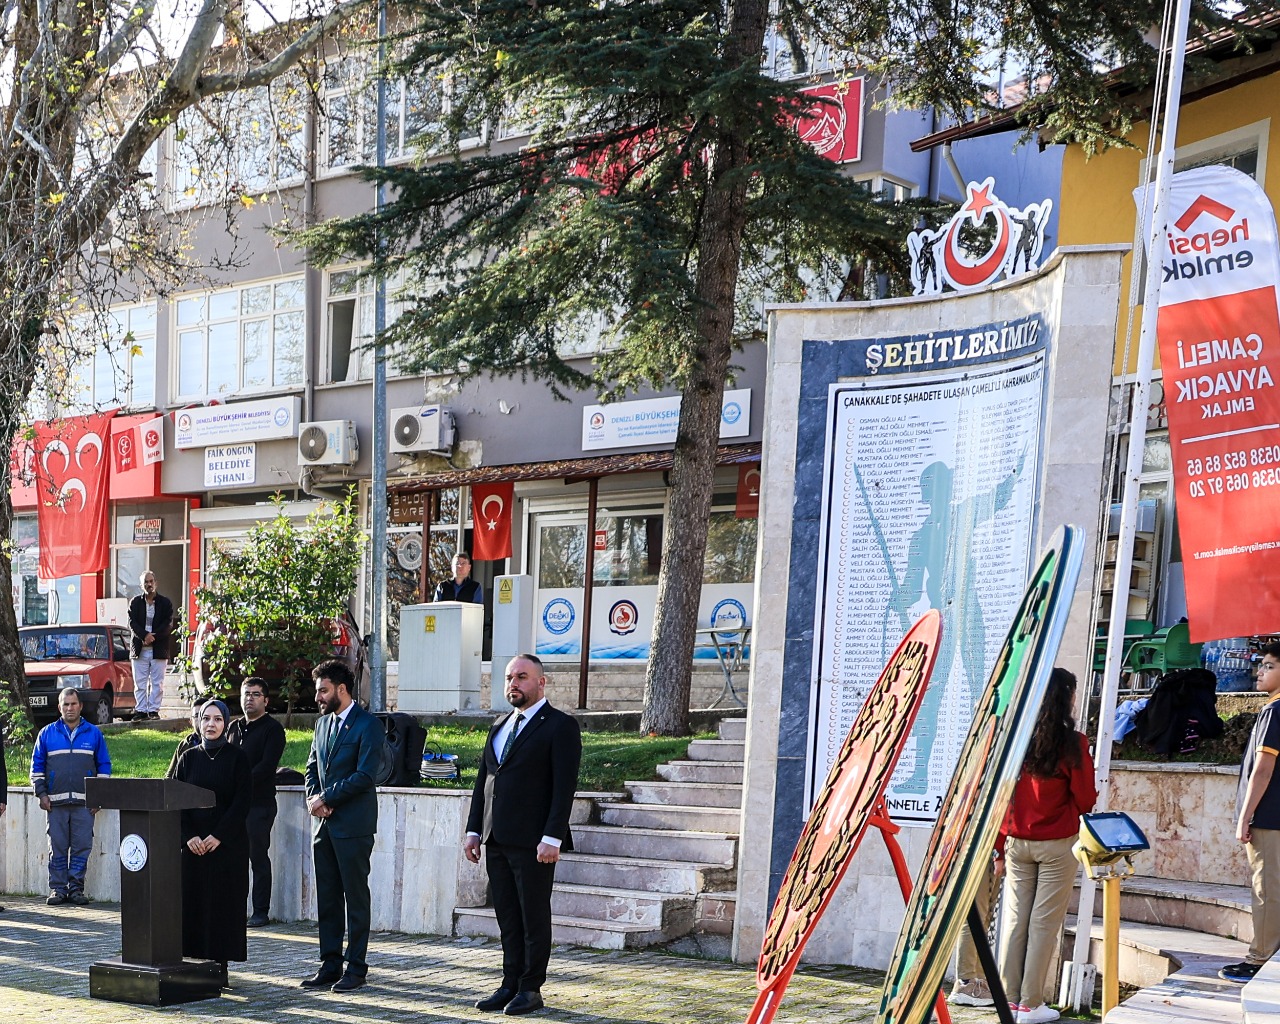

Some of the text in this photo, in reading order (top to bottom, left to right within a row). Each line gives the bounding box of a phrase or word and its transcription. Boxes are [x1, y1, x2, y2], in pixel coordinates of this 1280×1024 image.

[866, 316, 1039, 374] ŞEHİTLERİMİZ
[844, 394, 901, 409] ÇANAKKALE'DE
[904, 390, 941, 405] ŞAHADETE
[944, 386, 970, 399] ULAŞAN
[611, 409, 678, 424] DENİZLİ BÜYÜKŞEHİ
[148, 451, 160, 459] MHP
[208, 446, 253, 458] FAİK ONGUN
[209, 459, 251, 470] BELEDİYE
[214, 472, 244, 484] İŞHANI
[883, 794, 930, 811] İNNETLE
